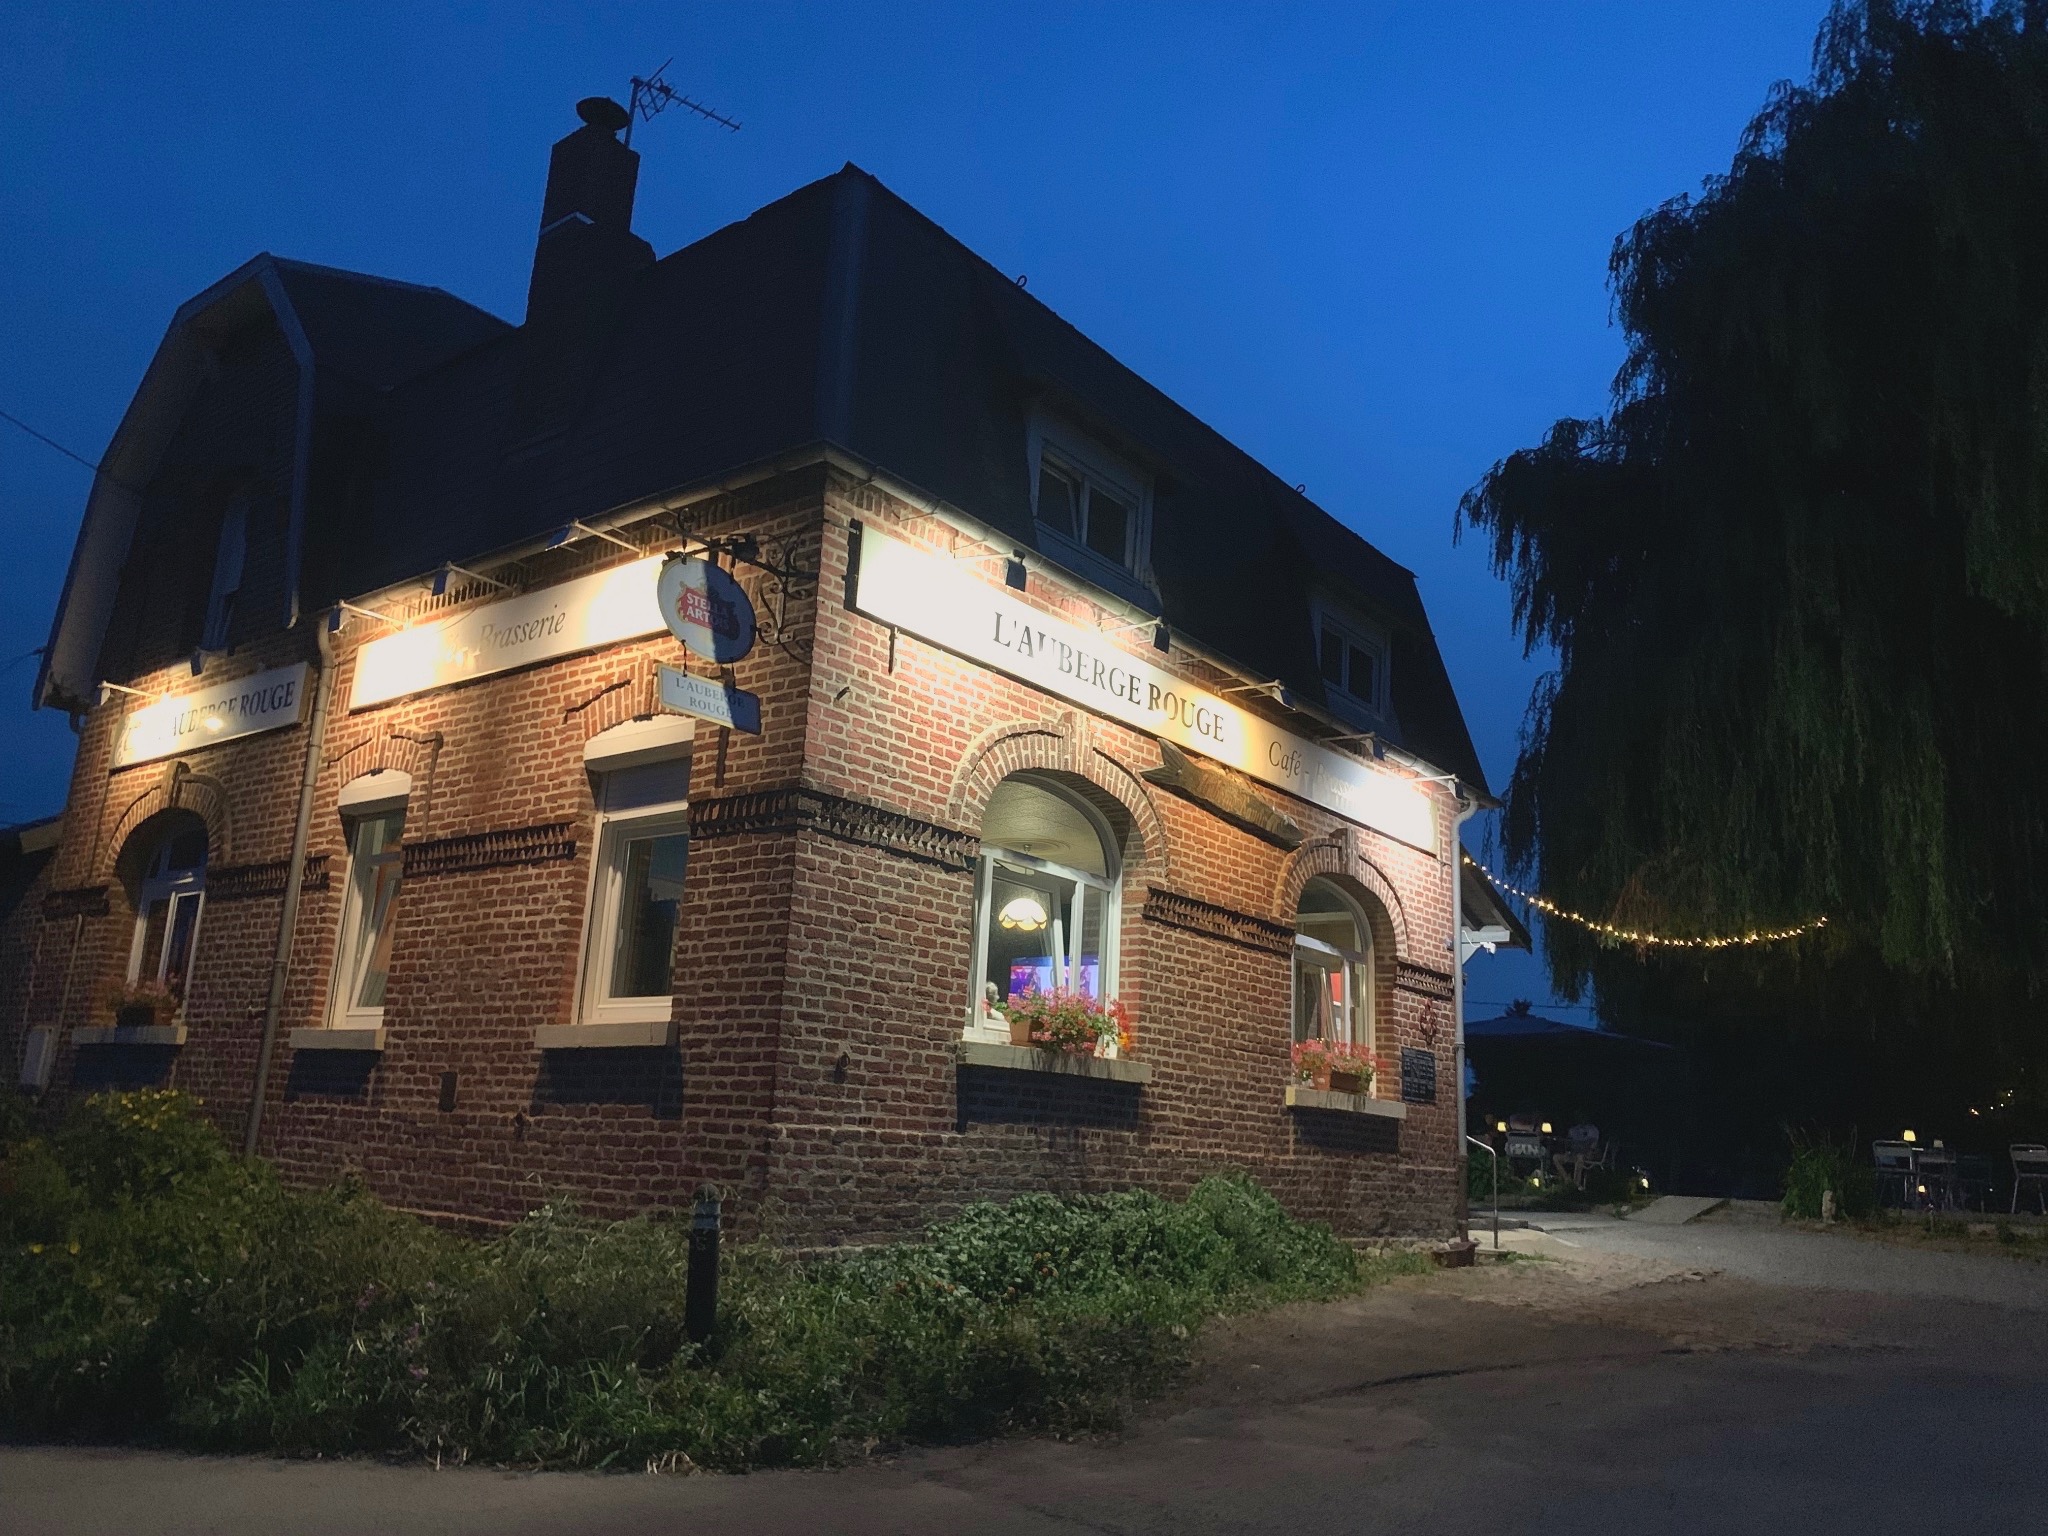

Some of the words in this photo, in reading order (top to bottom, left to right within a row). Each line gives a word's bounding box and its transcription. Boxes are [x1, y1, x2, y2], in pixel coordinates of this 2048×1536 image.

[686, 592, 729, 618] STELLA
[480, 604, 566, 650] Brasserie
[993, 611, 1143, 706] L'AUBERGE
[1147, 682, 1225, 743] ROUGE
[239, 681, 296, 718] ROUGE
[1269, 741, 1302, 778] Café
